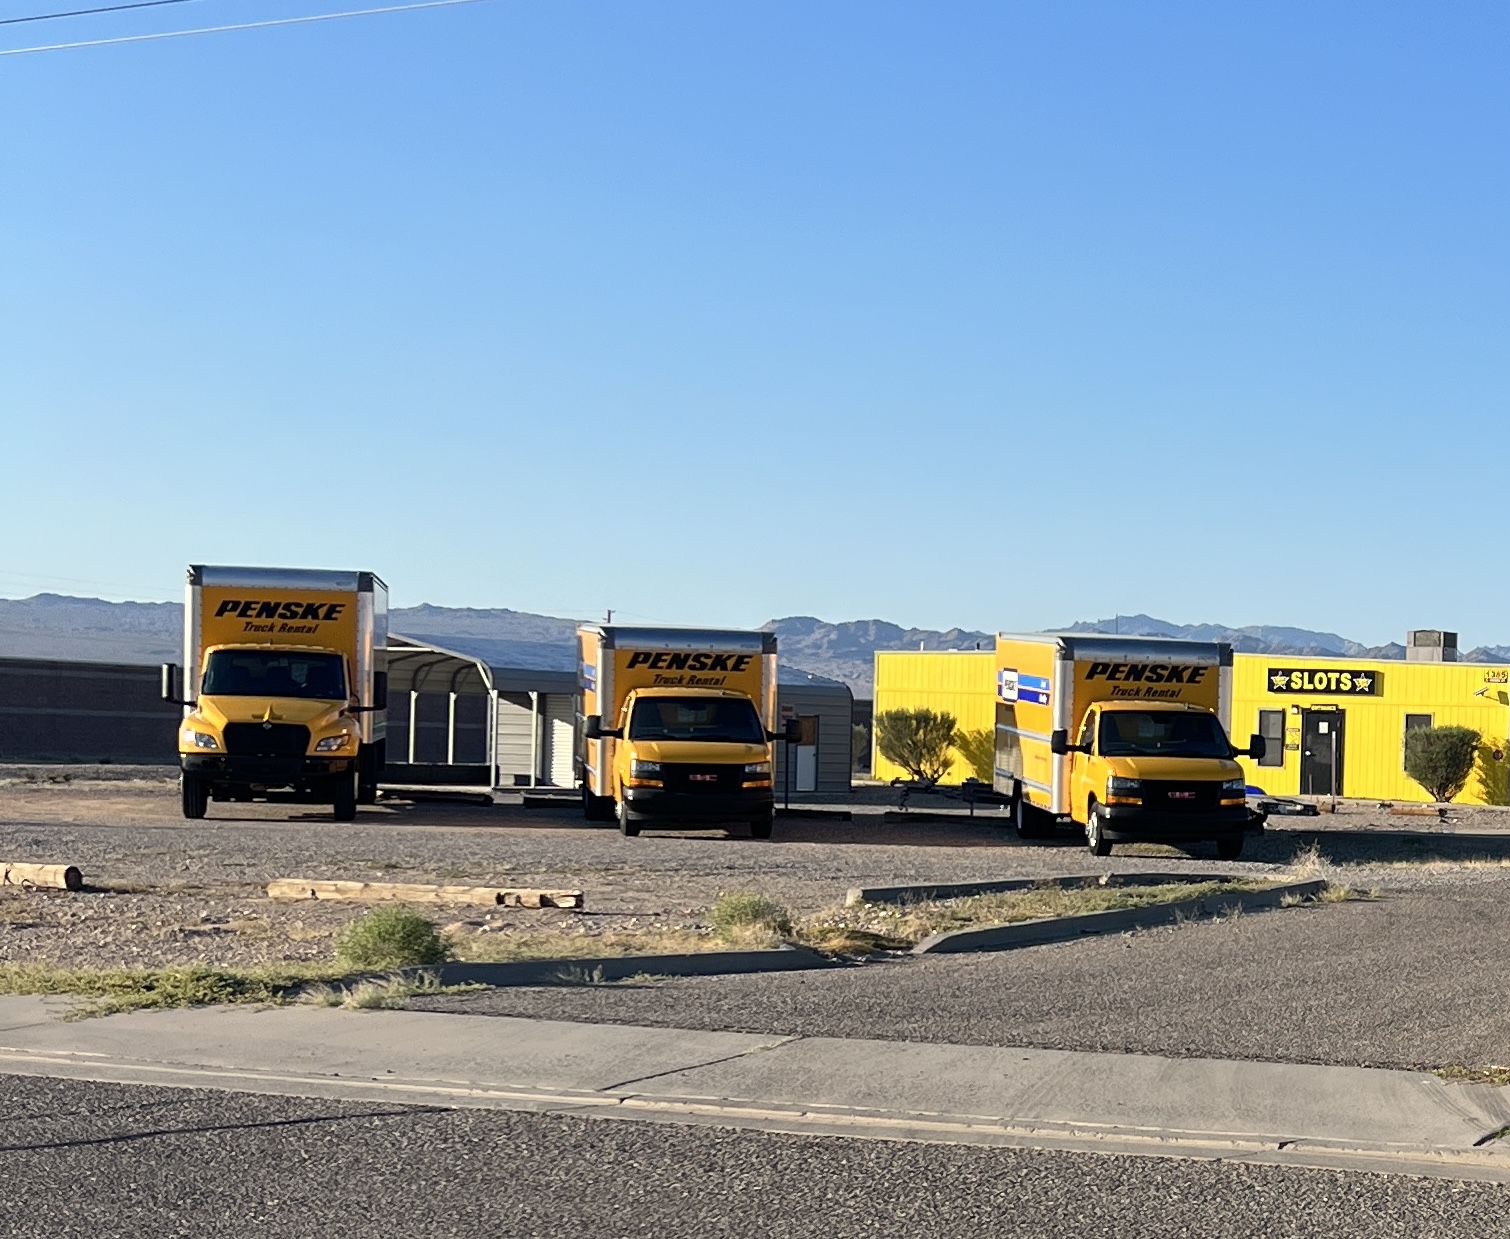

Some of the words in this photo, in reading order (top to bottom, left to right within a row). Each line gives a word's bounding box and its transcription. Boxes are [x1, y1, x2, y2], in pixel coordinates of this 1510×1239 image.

[214, 600, 346, 621] PENSKE
[243, 621, 275, 633] Truck
[278, 622, 320, 634] Rental
[626, 652, 754, 672] PENSKE
[653, 674, 684, 685] Truck
[687, 675, 727, 686] Rental
[1085, 662, 1209, 684] PENSKE
[1290, 671, 1352, 691] SLOTS
[1110, 686, 1142, 697] Truck
[1144, 687, 1182, 698] Rental
